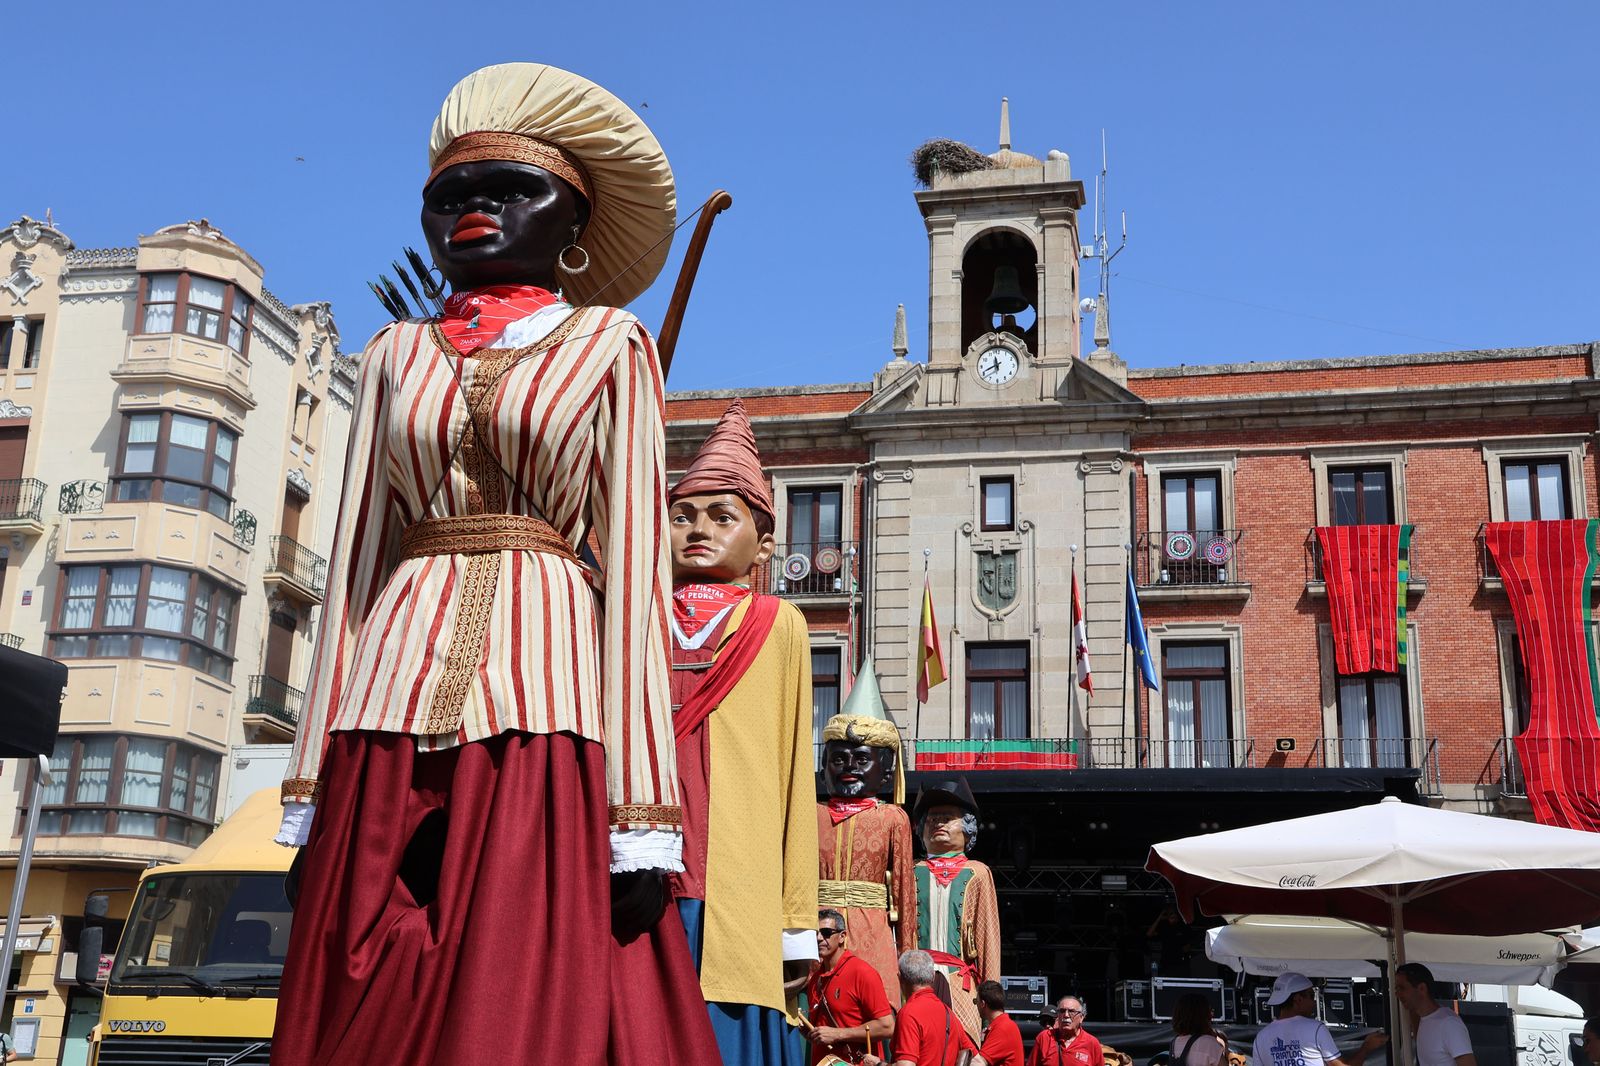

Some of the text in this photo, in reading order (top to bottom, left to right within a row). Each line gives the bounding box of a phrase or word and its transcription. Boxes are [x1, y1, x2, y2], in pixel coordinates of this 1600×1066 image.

[459, 337, 482, 346] ZAMORA
[688, 592, 714, 600] PEDRO
[108, 1020, 166, 1032] VOLVO
